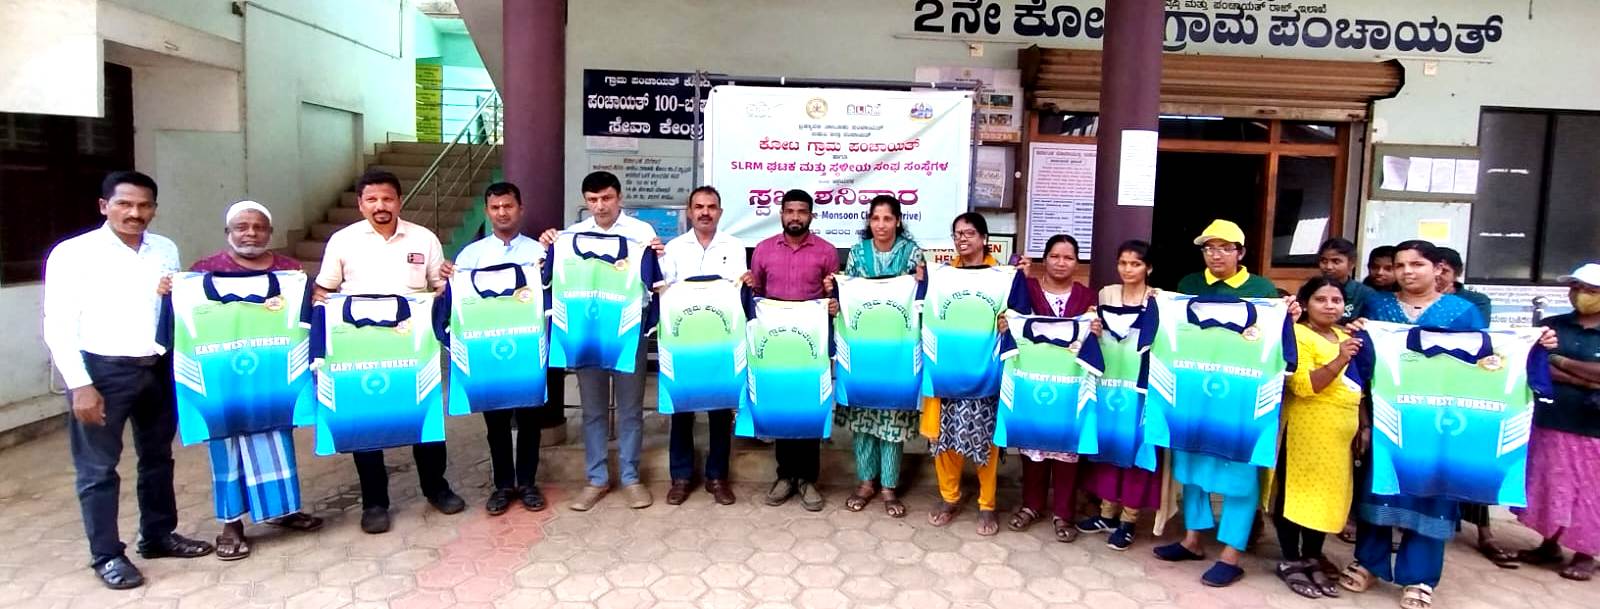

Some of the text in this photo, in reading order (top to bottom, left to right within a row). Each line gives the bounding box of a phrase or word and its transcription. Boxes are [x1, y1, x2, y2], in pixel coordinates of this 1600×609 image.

[1013, 0, 1104, 38] ಕೋ
[1163, 9, 1259, 51] ಗ್ರಾಮ
[1268, 12, 1504, 54] ಪಂಚಾಯತ್
[587, 93, 650, 111] ಪಂಚಾಯತ್
[608, 116, 651, 134] ಸೇವಾ
[759, 136, 799, 151] ಕೋಟ
[807, 141, 841, 156] ಗ್ರಾಮ
[731, 161, 763, 170] SLRM
[799, 162, 827, 176] ಮತ್ತು
[1396, 394, 1506, 413] EAST WEST NURSERY
